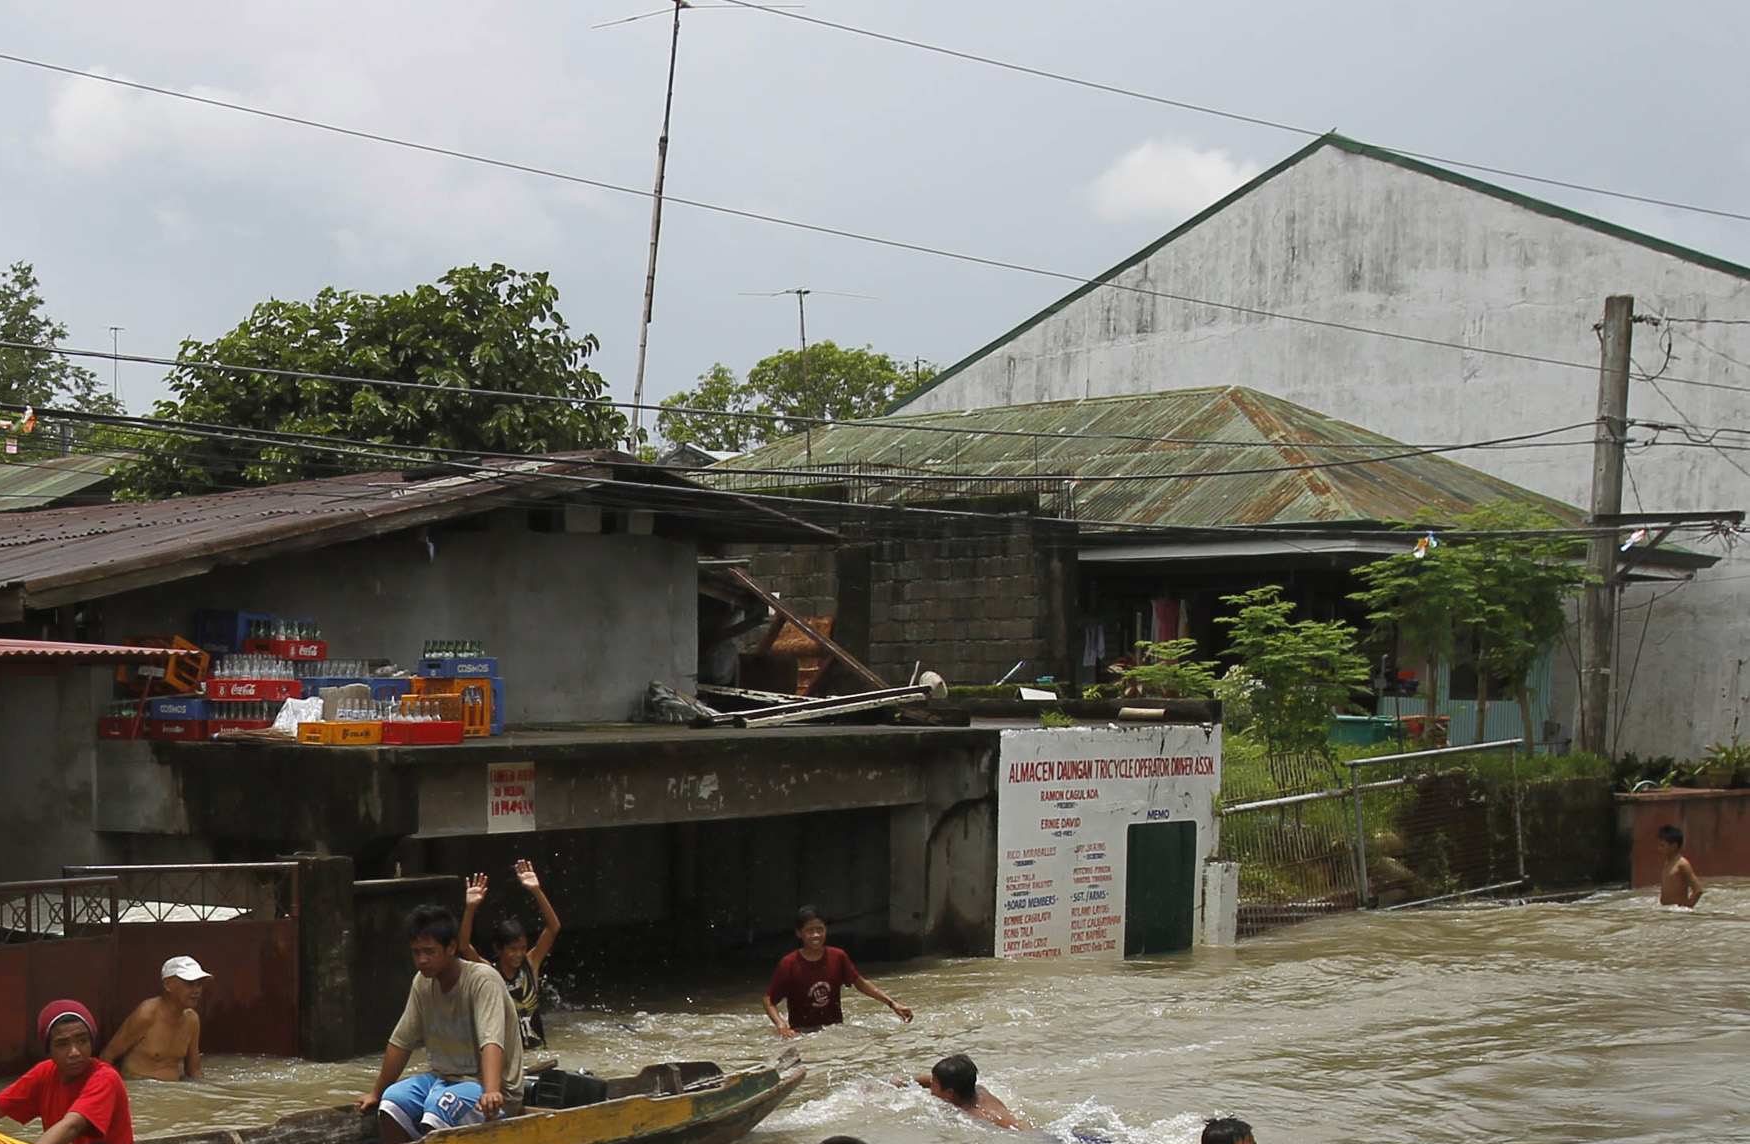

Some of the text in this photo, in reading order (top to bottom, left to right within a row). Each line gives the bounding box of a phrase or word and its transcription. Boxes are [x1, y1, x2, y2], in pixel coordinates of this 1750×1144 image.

[457, 663, 489, 673] COSMOS
[1008, 761, 1055, 784] ALMACEN
[1094, 758, 1134, 780] TRICYCLE
[1134, 757, 1170, 778] OPERATOR
[1040, 790, 1064, 802] RAMON
[1146, 809, 1170, 820] MEMO
[1041, 817, 1082, 830] ERNIE DAVID
[1006, 895, 1056, 910] BOARD MEMBERS
